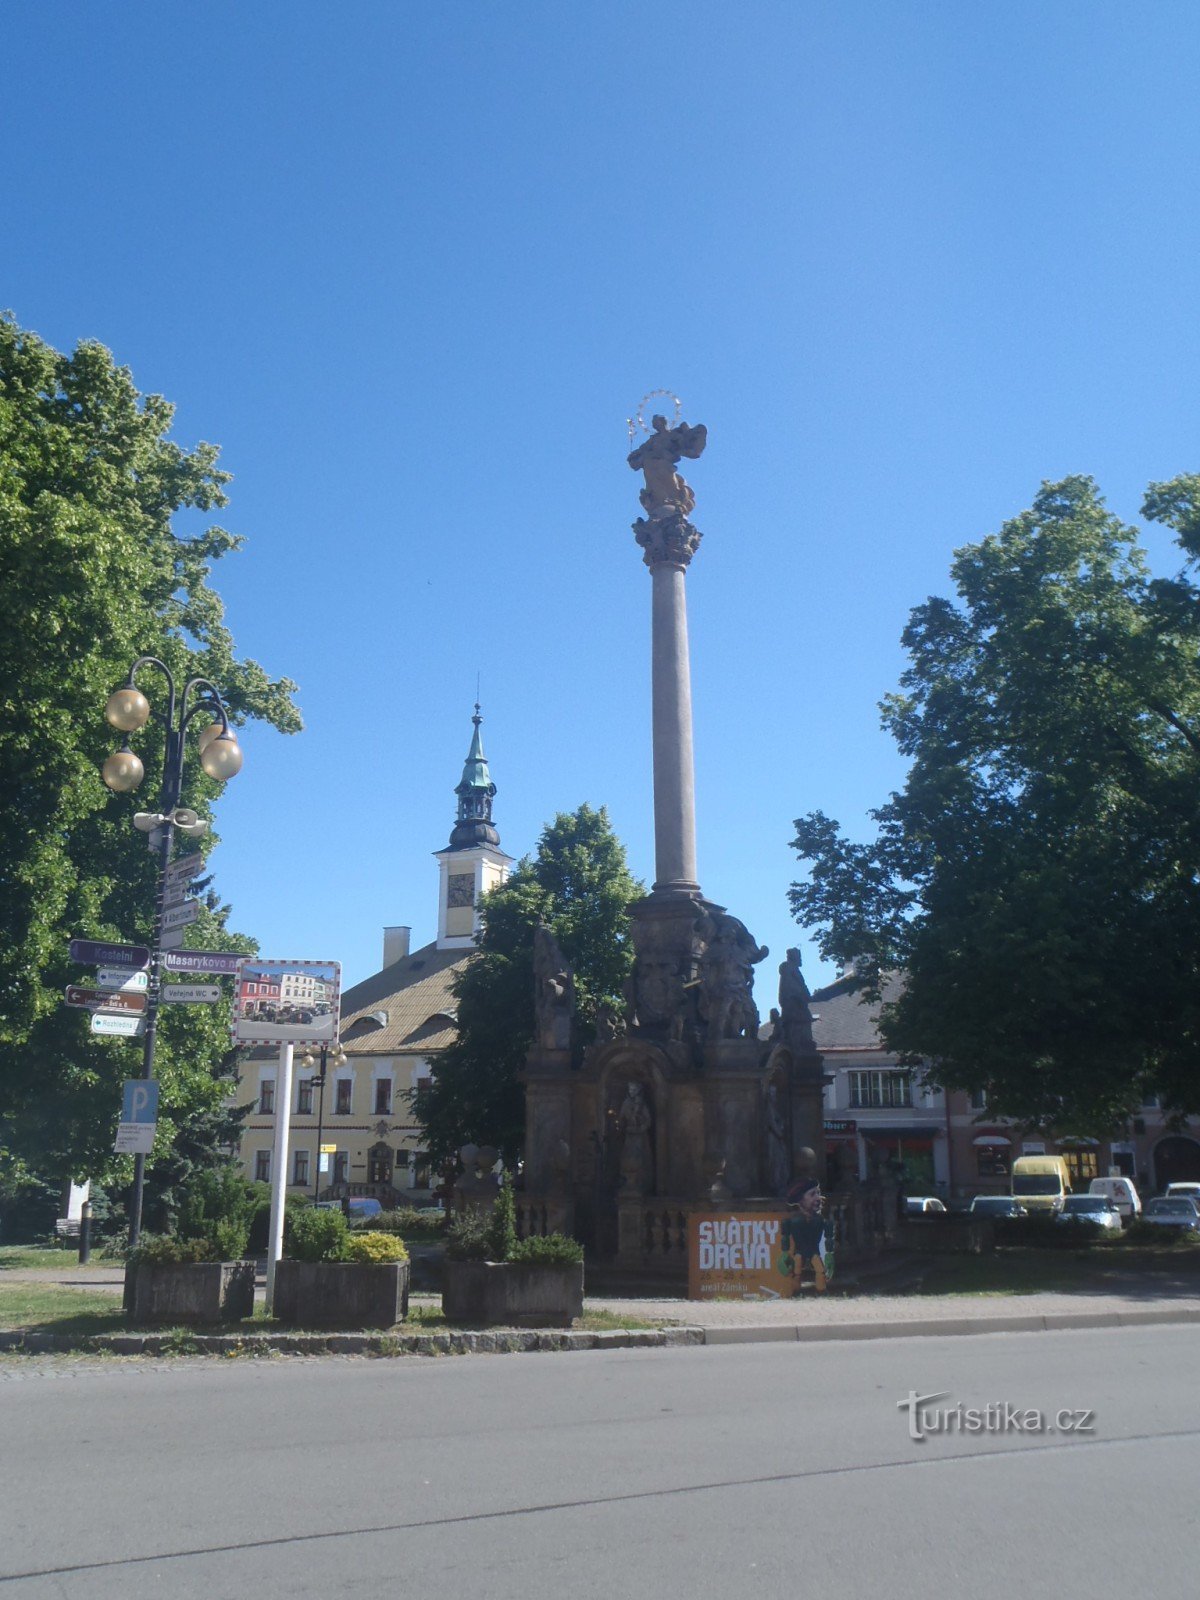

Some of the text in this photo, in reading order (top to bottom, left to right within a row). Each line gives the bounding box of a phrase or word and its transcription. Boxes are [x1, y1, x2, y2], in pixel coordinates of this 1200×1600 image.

[95, 947, 133, 962] Kostelní
[168, 955, 226, 969] Masarykovo
[195, 990, 207, 998] WC
[131, 1087, 148, 1123] P
[699, 1216, 779, 1244] SVÁTKY
